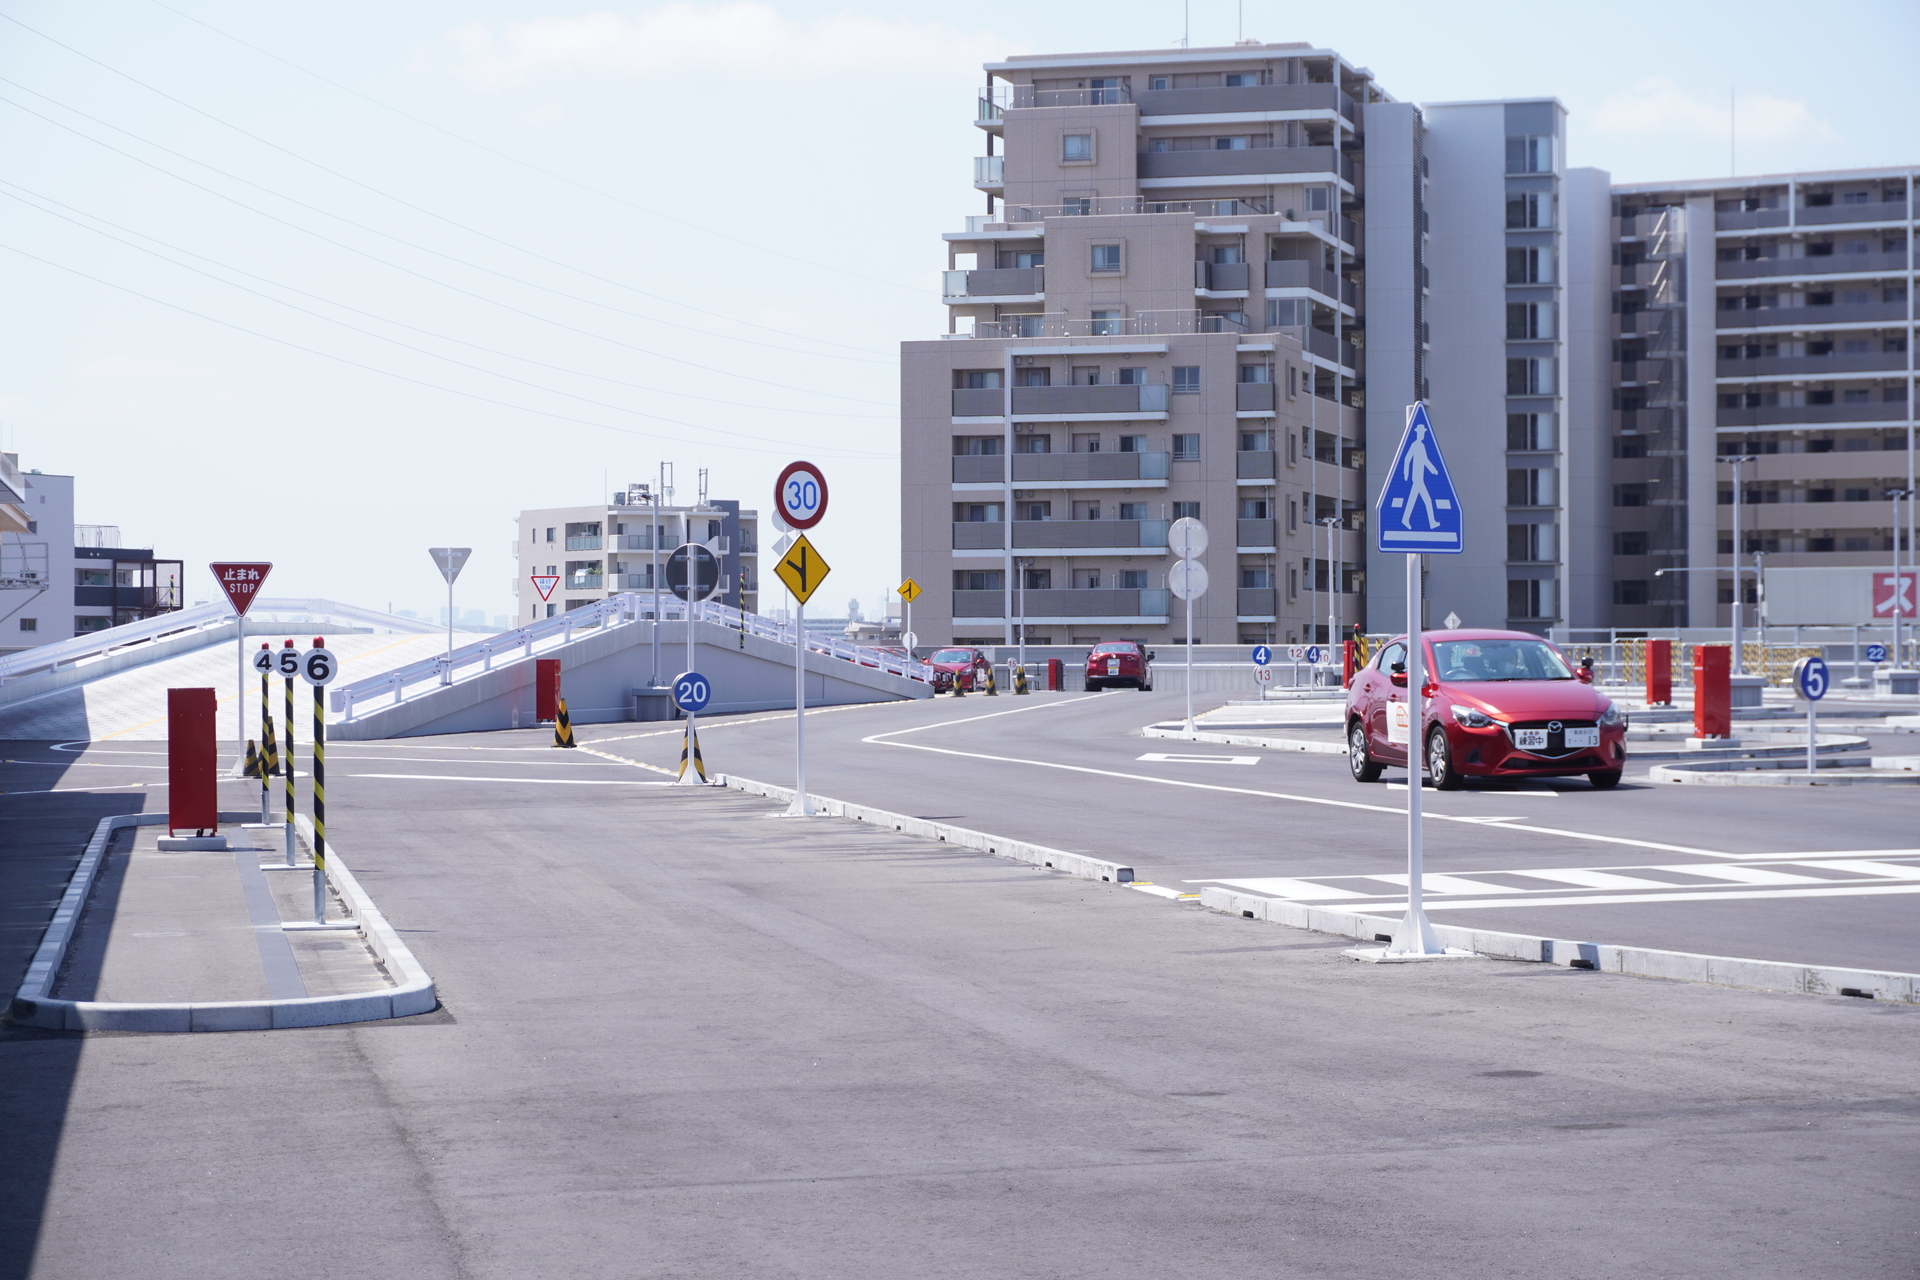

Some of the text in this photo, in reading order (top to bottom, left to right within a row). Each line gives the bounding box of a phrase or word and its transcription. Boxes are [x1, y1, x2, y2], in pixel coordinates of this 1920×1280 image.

[788, 480, 817, 510] 30
[223, 568, 260, 580] 止まれ
[229, 583, 255, 593] STOP
[1875, 577, 1914, 613] ス
[1256, 647, 1266, 663] 4
[1289, 648, 1303, 658] 12
[1309, 648, 1317, 662] 4
[1868, 647, 1885, 660] 22
[256, 654, 272, 670] 4
[280, 653, 298, 673] 5
[307, 654, 330, 680] 6
[1008, 660, 1017, 668] 15
[1258, 669, 1271, 681] 13
[1806, 662, 1824, 697] 5
[679, 681, 706, 703] 20
[1519, 735, 1544, 746] 練習中
[1588, 735, 1598, 746] 13
